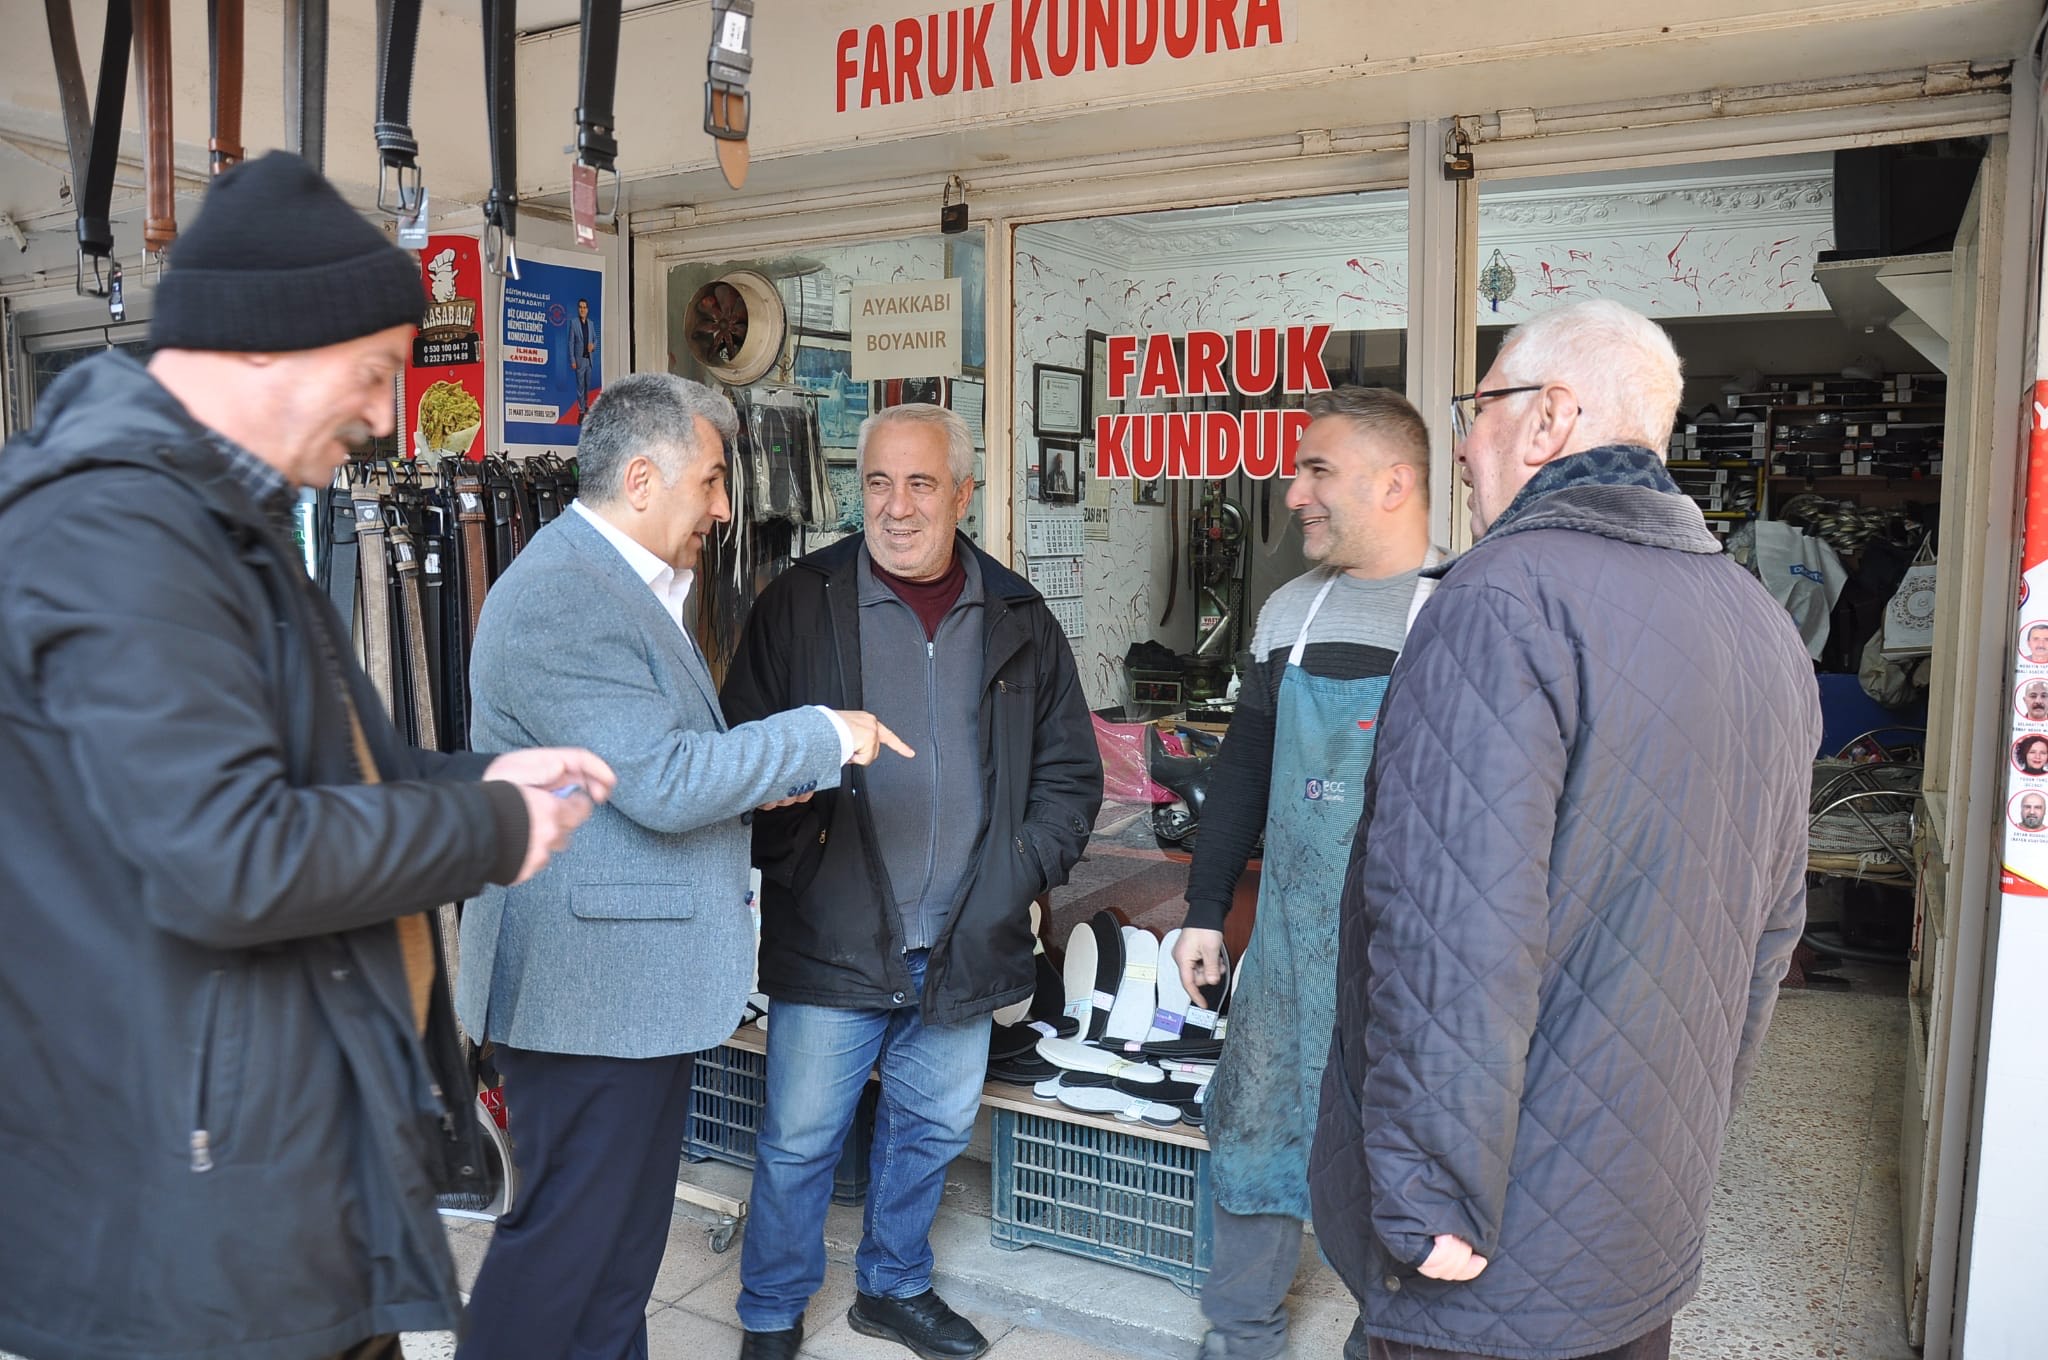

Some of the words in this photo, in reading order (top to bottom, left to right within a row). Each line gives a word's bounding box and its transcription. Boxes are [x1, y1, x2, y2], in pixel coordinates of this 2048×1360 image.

[836, 2, 995, 113] FARUK
[862, 293, 950, 317] AYAKKABI
[429, 345, 440, 353] 530
[441, 343, 452, 351] 100
[460, 342, 468, 350] 73
[866, 330, 947, 352] BOYANIR
[1106, 323, 1335, 401] FARUK
[1095, 408, 1314, 481] KUNDUR
[1083, 507, 1096, 522] ZASI
